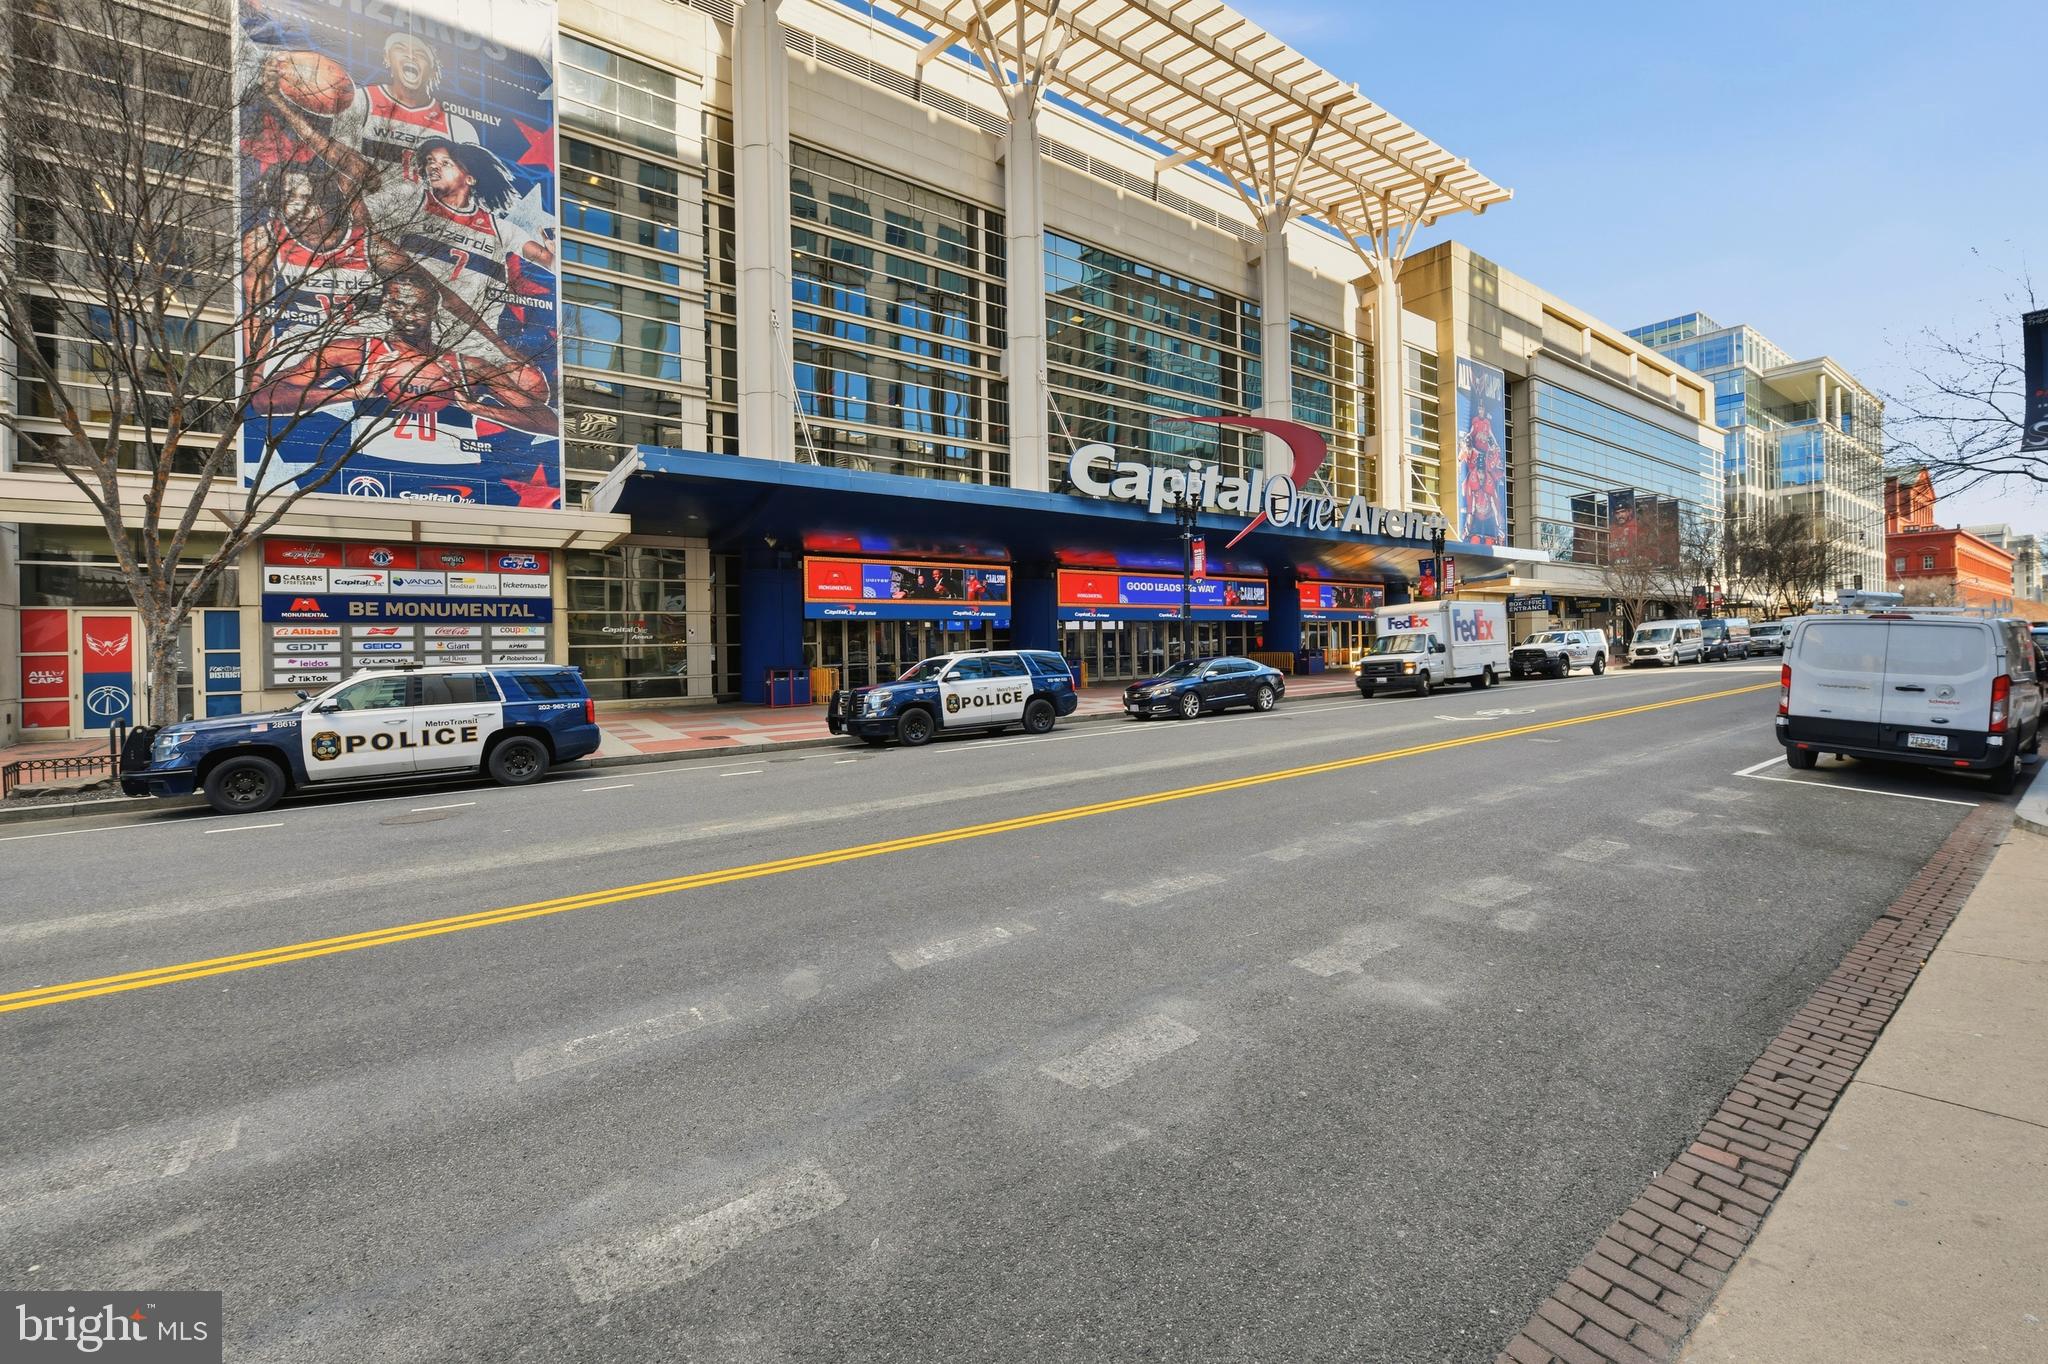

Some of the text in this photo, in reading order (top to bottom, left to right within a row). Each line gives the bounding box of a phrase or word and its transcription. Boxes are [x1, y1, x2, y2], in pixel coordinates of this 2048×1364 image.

[442, 101, 502, 127] COULIBALY
[450, 248, 470, 281] 7
[393, 411, 438, 443] 20
[462, 440, 493, 453] SARR
[1068, 443, 1264, 514] Capital
[1340, 495, 1440, 542] Arena
[282, 574, 323, 582] CAESARS
[502, 582, 549, 590] ticketmaster
[1126, 582, 1154, 591] GOOD
[1155, 583, 1182, 592] LEADS
[1198, 585, 1216, 593] WAY
[348, 601, 535, 618] BE MONUMENTAL
[1509, 604, 1547, 612] ENTRANCE
[1387, 614, 1429, 631] FedEx
[1452, 608, 1494, 642] FedEx
[290, 627, 339, 636] Alibaba
[286, 642, 329, 651] GDIT
[362, 642, 402, 650] GEICO
[446, 642, 470, 650] Giant
[299, 659, 329, 668] leidos
[29, 670, 53, 678] ALL
[28, 676, 64, 684] CAPS
[961, 691, 1023, 709] POLICE
[272, 720, 297, 729] 28615
[345, 725, 478, 754] POLICE
